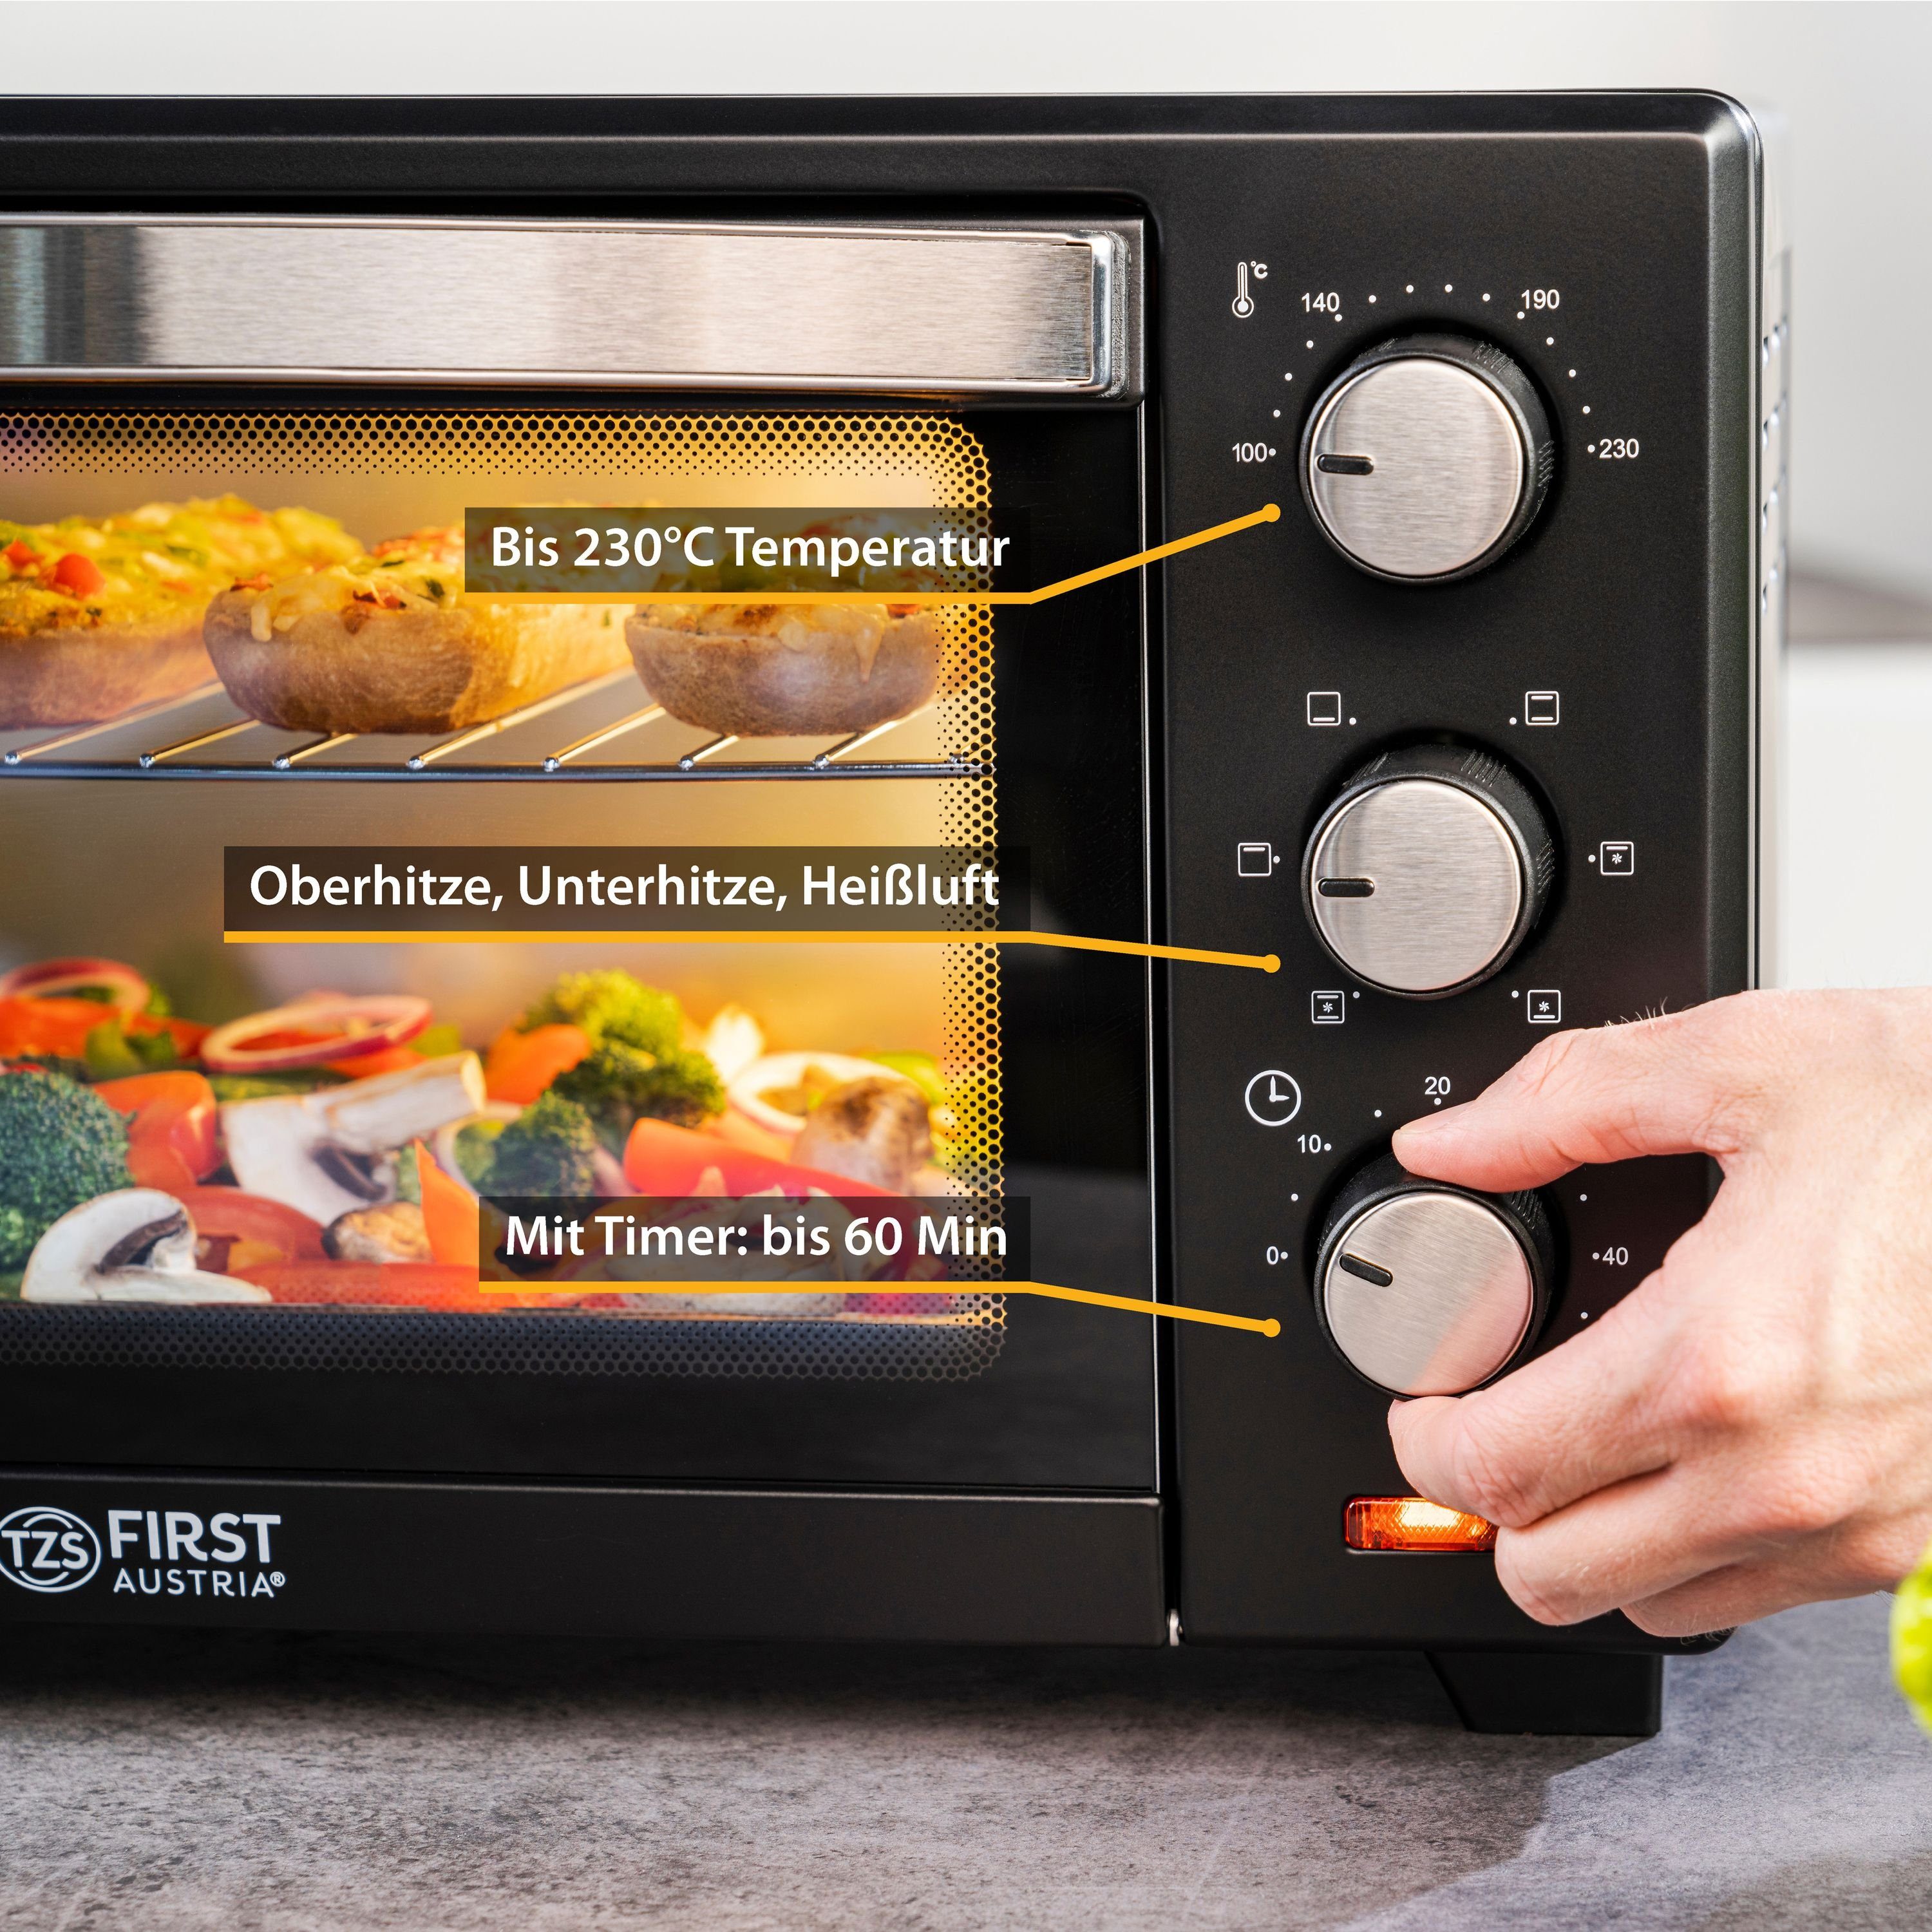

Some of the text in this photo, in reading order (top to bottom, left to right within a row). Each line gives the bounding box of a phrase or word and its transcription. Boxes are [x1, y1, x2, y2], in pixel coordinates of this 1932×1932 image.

[1302, 292, 1340, 312] 140
[1521, 289, 1560, 310] 190
[1232, 442, 1267, 462] 100
[1599, 438, 1640, 459] 230
[1425, 1076, 1451, 1095] 20
[1297, 1134, 1321, 1153] 10
[1266, 1245, 1279, 1265] 0
[1602, 1247, 1629, 1265] 40
[108, 1510, 281, 1564] FIRST
[1, 1530, 89, 1570] TZS
